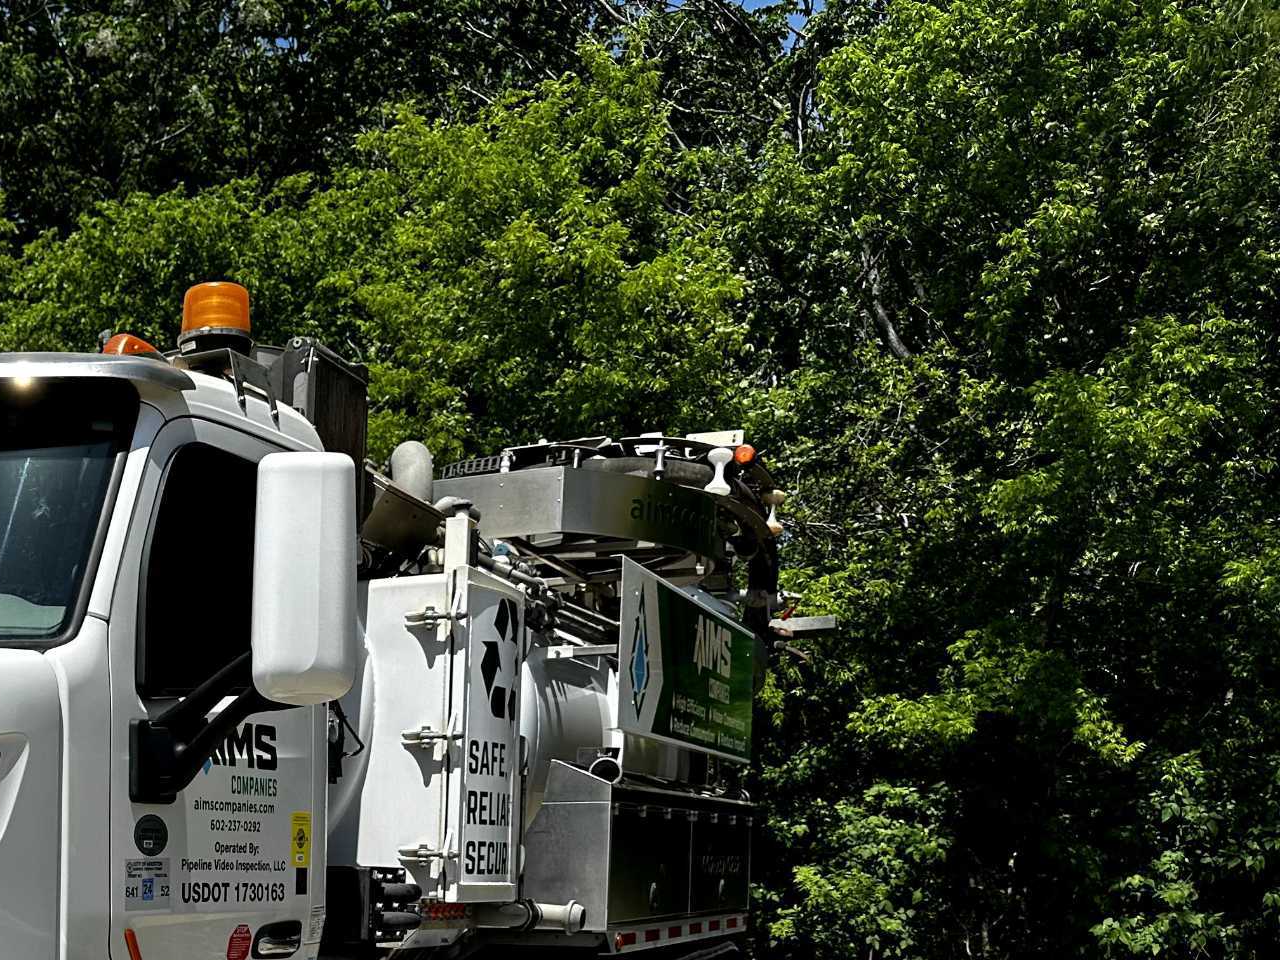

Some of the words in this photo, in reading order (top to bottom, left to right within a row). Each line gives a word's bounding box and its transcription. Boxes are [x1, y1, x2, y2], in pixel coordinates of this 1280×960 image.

[693, 614, 732, 678] AIMS
[213, 723, 277, 771] IMS
[231, 775, 277, 797] COMPANIES
[193, 797, 275, 814] aimscompanies.com
[210, 819, 261, 832] 602-237-0292
[214, 841, 247, 855] Operated
[248, 842, 260, 856] By:
[181, 858, 212, 873] Pipeline
[214, 859, 234, 871] Video
[236, 860, 272, 873] Inspection,
[273, 861, 286, 872] LLC
[181, 882, 230, 903] USDOT
[234, 882, 285, 902] 1730163
